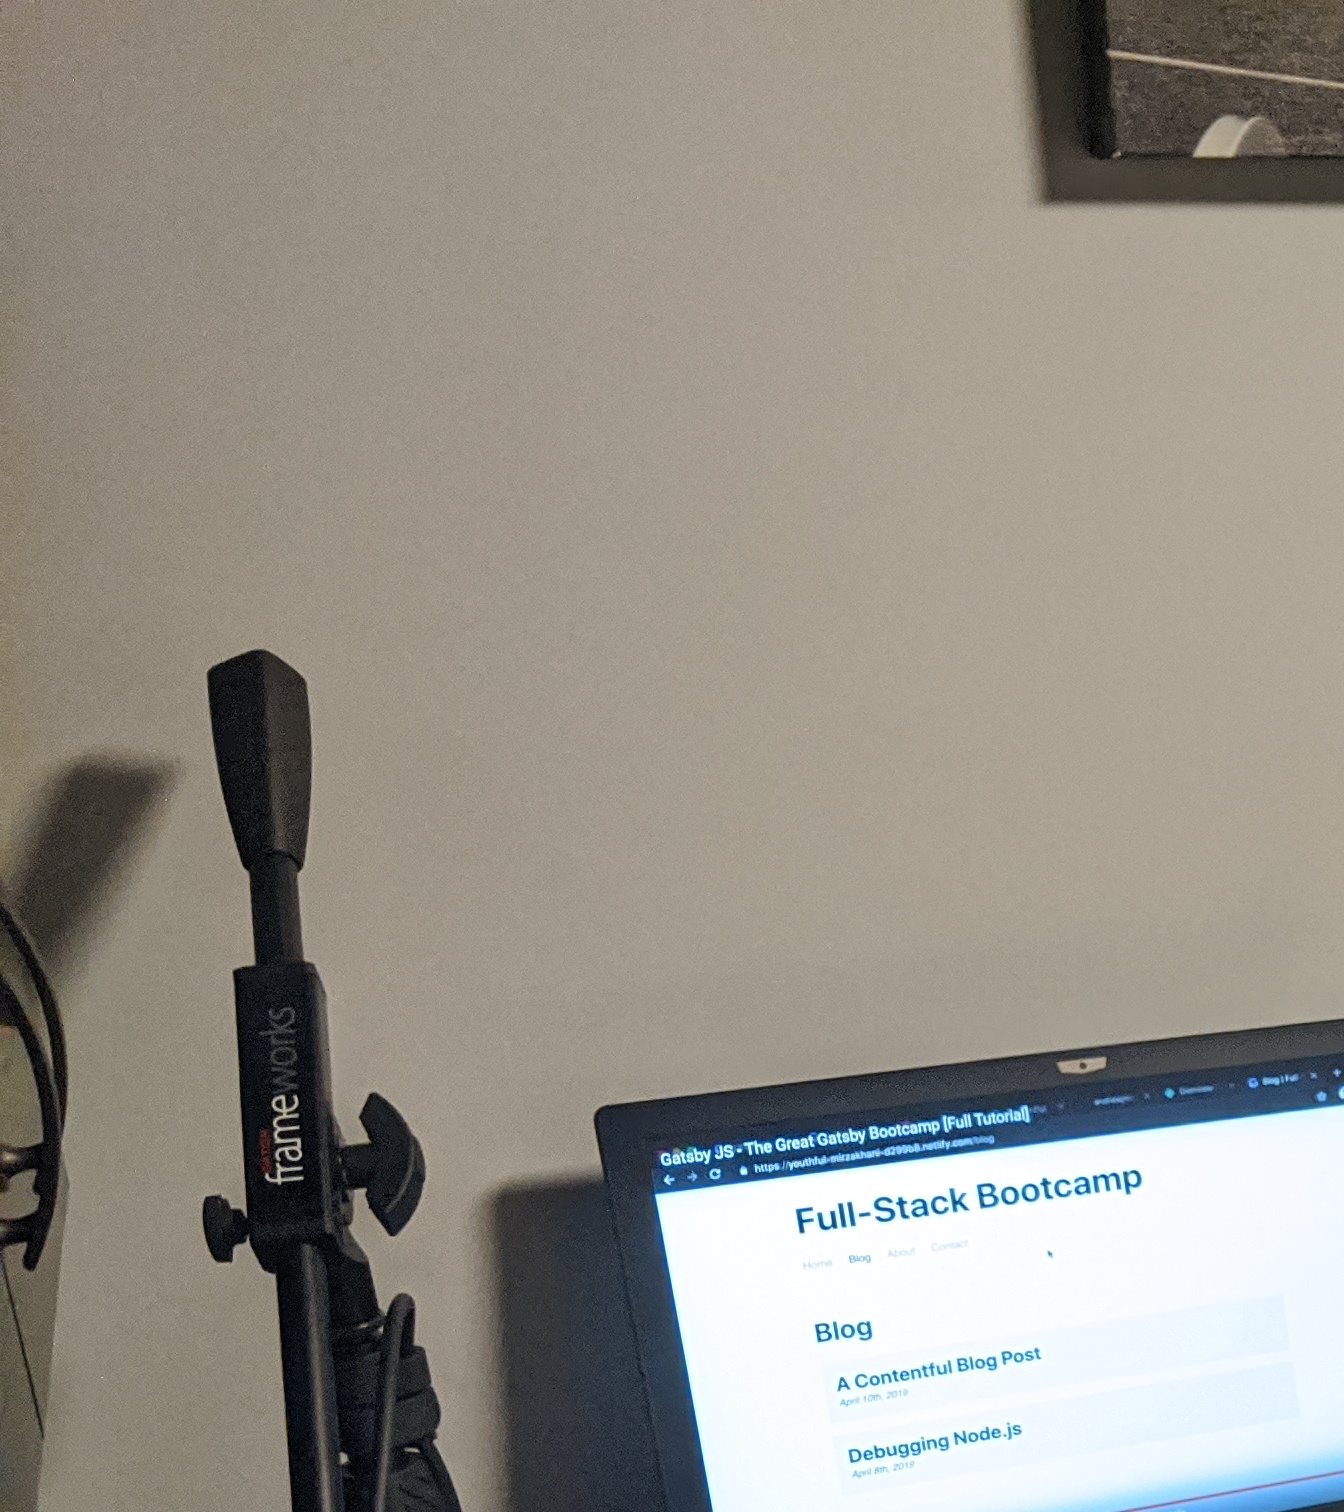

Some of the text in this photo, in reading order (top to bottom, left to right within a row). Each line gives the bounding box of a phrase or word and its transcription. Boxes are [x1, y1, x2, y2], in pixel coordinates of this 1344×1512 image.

[259, 1006, 304, 1185] frameworks
[660, 1144, 712, 1168] Gatsby
[714, 1143, 735, 1161] JS
[744, 1138, 773, 1158] The
[775, 1133, 815, 1154] Great
[817, 1126, 866, 1152] Gatsby
[868, 1119, 941, 1145] Bootcamp
[943, 1112, 973, 1135] [Full
[974, 1105, 1030, 1129] Tutorial]
[795, 1166, 1143, 1235] Full-Stack Bootcamp
[803, 1238, 969, 1271] Home Blog About Contact
[814, 1319, 874, 1344] Blog
[836, 1347, 1042, 1392] A Contentful Blog Post
[839, 1388, 909, 1408] April 10th, 2019
[848, 1421, 1023, 1465] Debugging Node.js
[851, 1468, 872, 1480] April
[893, 1459, 916, 1472] 2019
